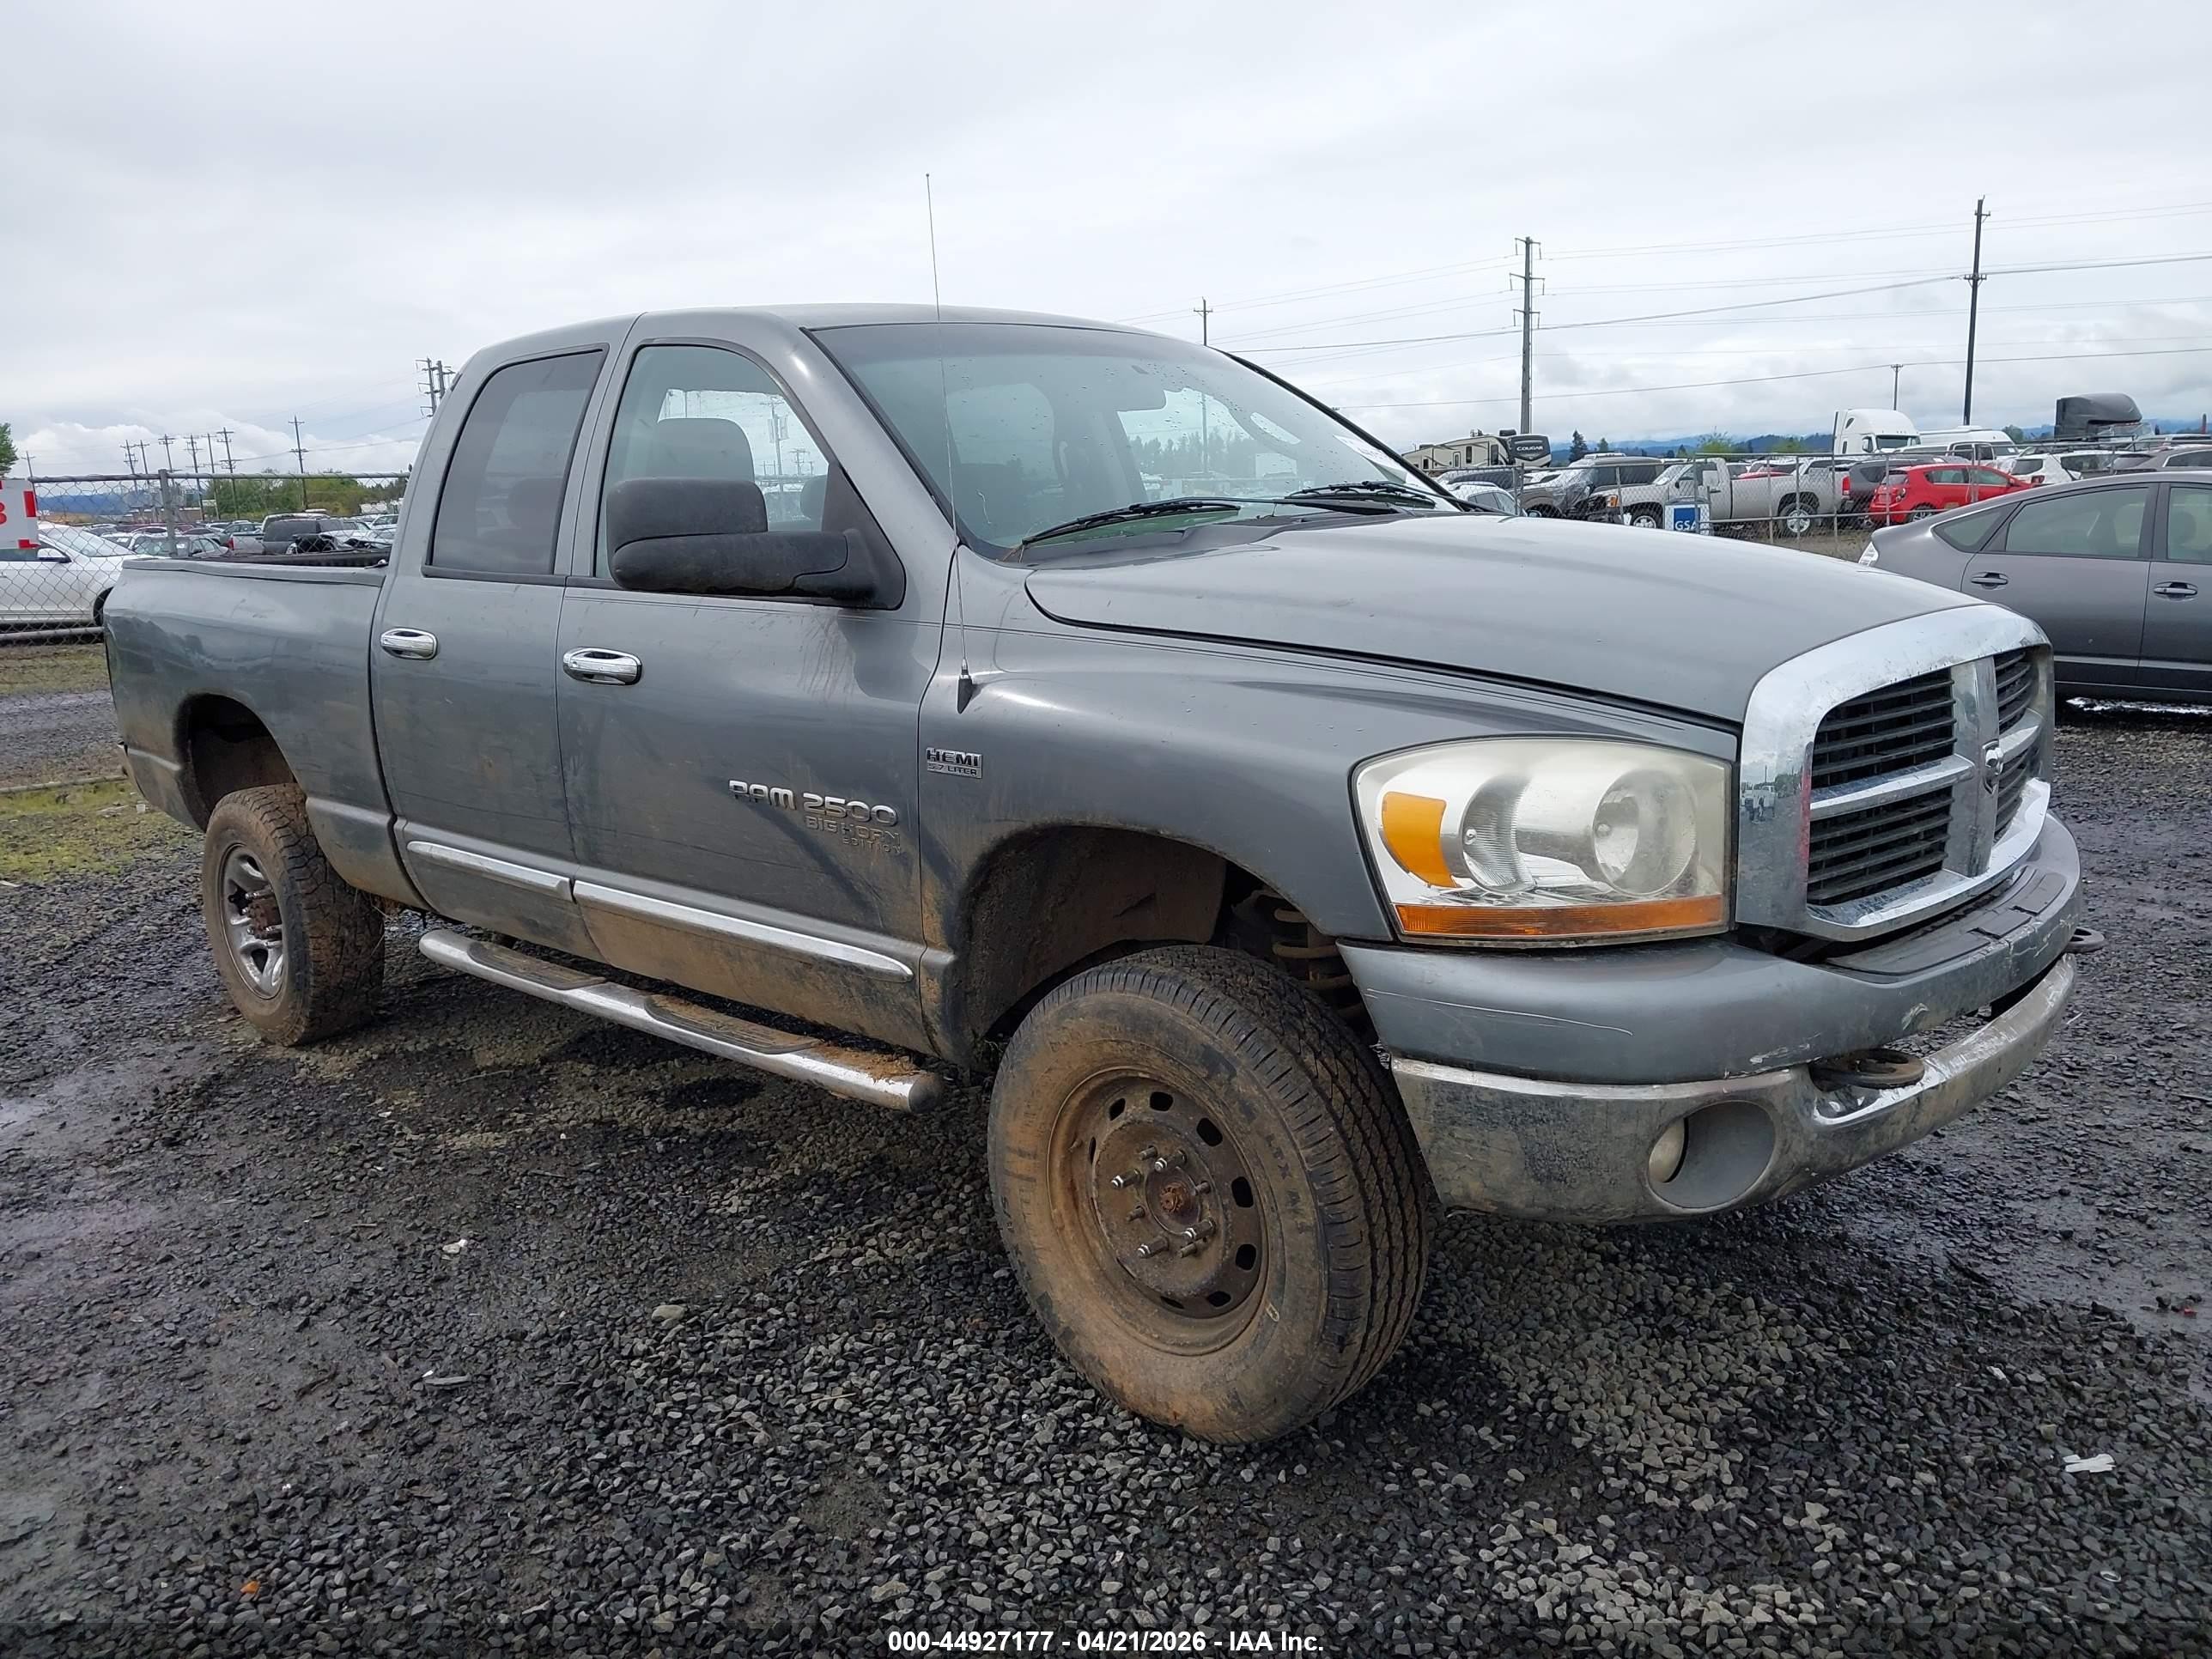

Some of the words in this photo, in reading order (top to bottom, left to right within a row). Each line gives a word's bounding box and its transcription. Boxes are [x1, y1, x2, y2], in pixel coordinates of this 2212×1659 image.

[927, 748, 981, 767] HEMI
[947, 765, 978, 777] LITER
[728, 779, 797, 811] RAM
[802, 792, 898, 827] 2500
[805, 816, 839, 834] BIG
[840, 822, 901, 846] HORN
[842, 837, 902, 856] EDITION
